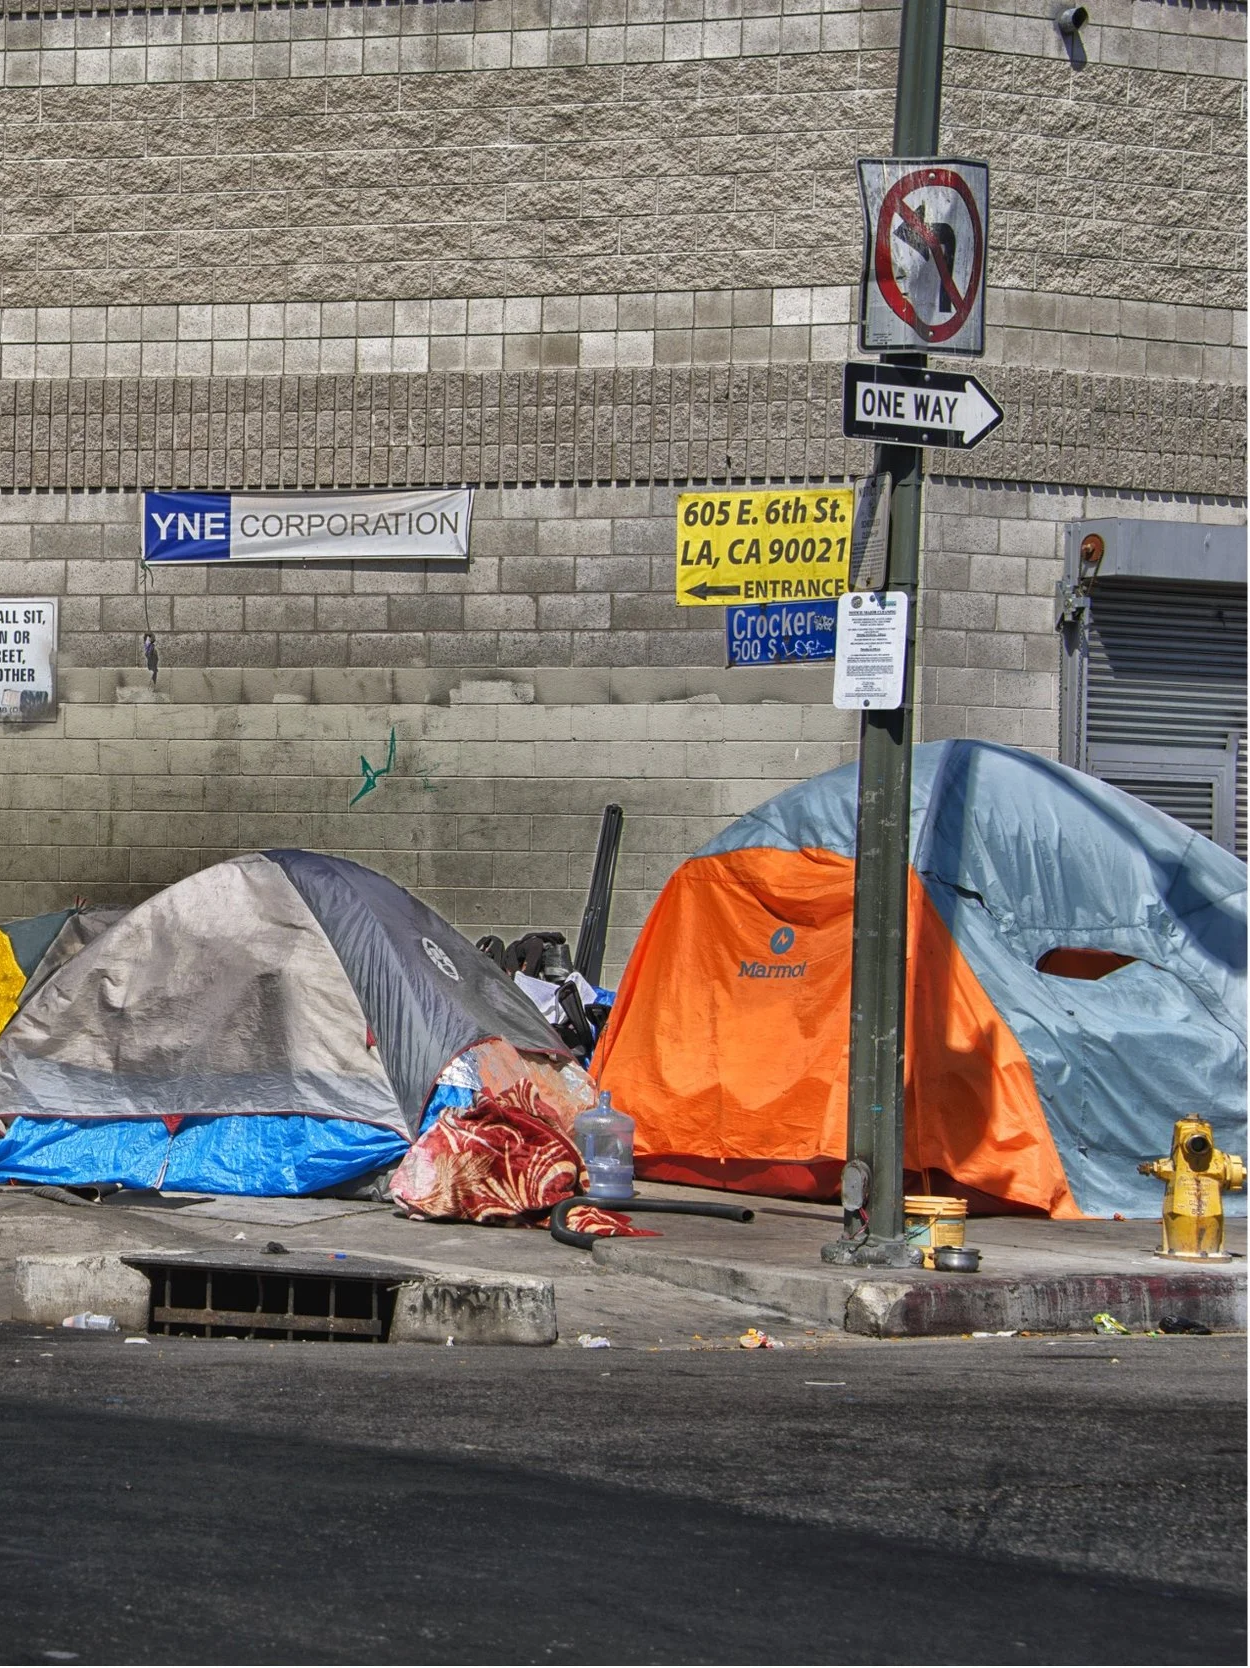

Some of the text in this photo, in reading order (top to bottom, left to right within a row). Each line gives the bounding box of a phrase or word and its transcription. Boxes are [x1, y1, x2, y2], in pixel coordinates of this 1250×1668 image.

[862, 388, 958, 424] ONE WAY
[151, 511, 459, 541] YNE CORPORATION
[684, 497, 846, 527] 605 E. 6th St.
[681, 540, 720, 569] LA,
[728, 538, 761, 565] CA
[768, 537, 847, 564] 90021
[743, 578, 845, 599] ENTRANCE
[23, 610, 46, 626] SIT,
[733, 607, 815, 640] Crocker
[13, 631, 30, 645] OR
[732, 638, 777, 661] 500 S
